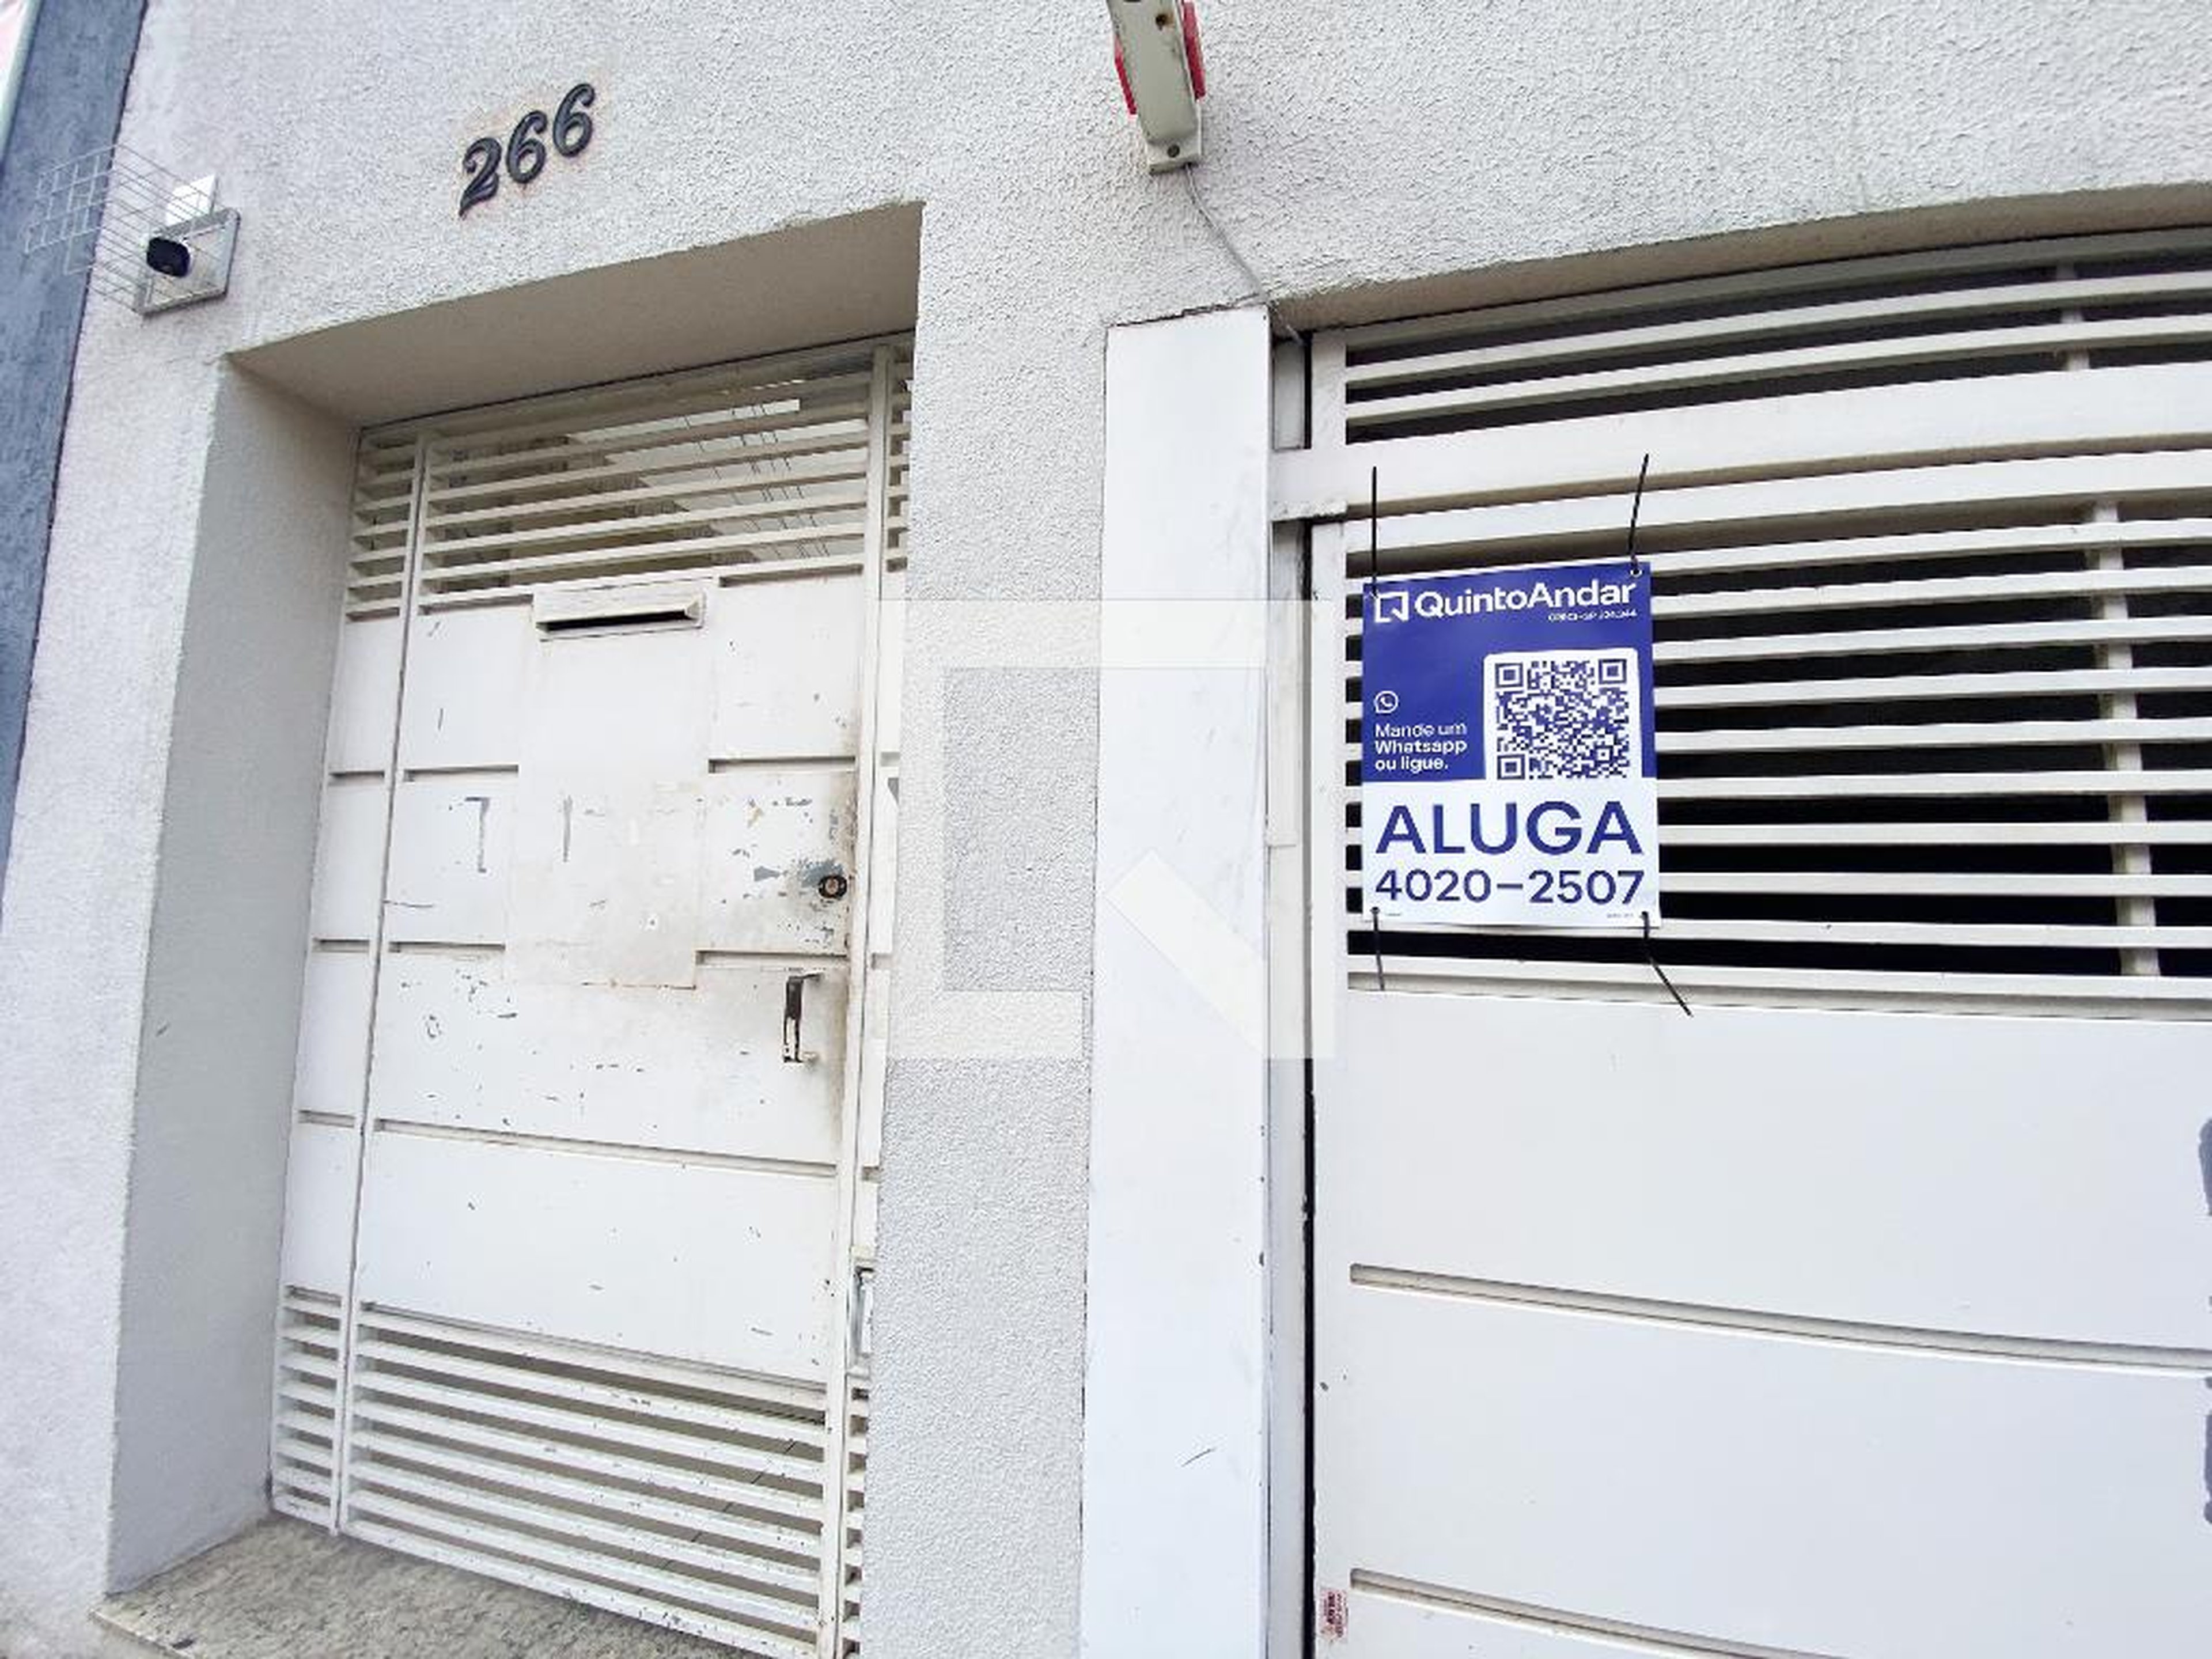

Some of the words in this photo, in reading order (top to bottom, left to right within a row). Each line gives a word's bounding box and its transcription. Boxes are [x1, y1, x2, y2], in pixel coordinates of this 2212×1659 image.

[459, 83, 595, 217] 266
[1414, 579, 1637, 618] QuintoAndar
[1375, 723, 1435, 737] Mande
[1438, 722, 1468, 736] um
[1374, 740, 1467, 755] Whatsapp
[1374, 759, 1396, 771] ou
[1401, 756, 1448, 774] ligue.
[1375, 801, 1643, 854] ALUGA
[1375, 869, 1645, 904] 4020-2507
